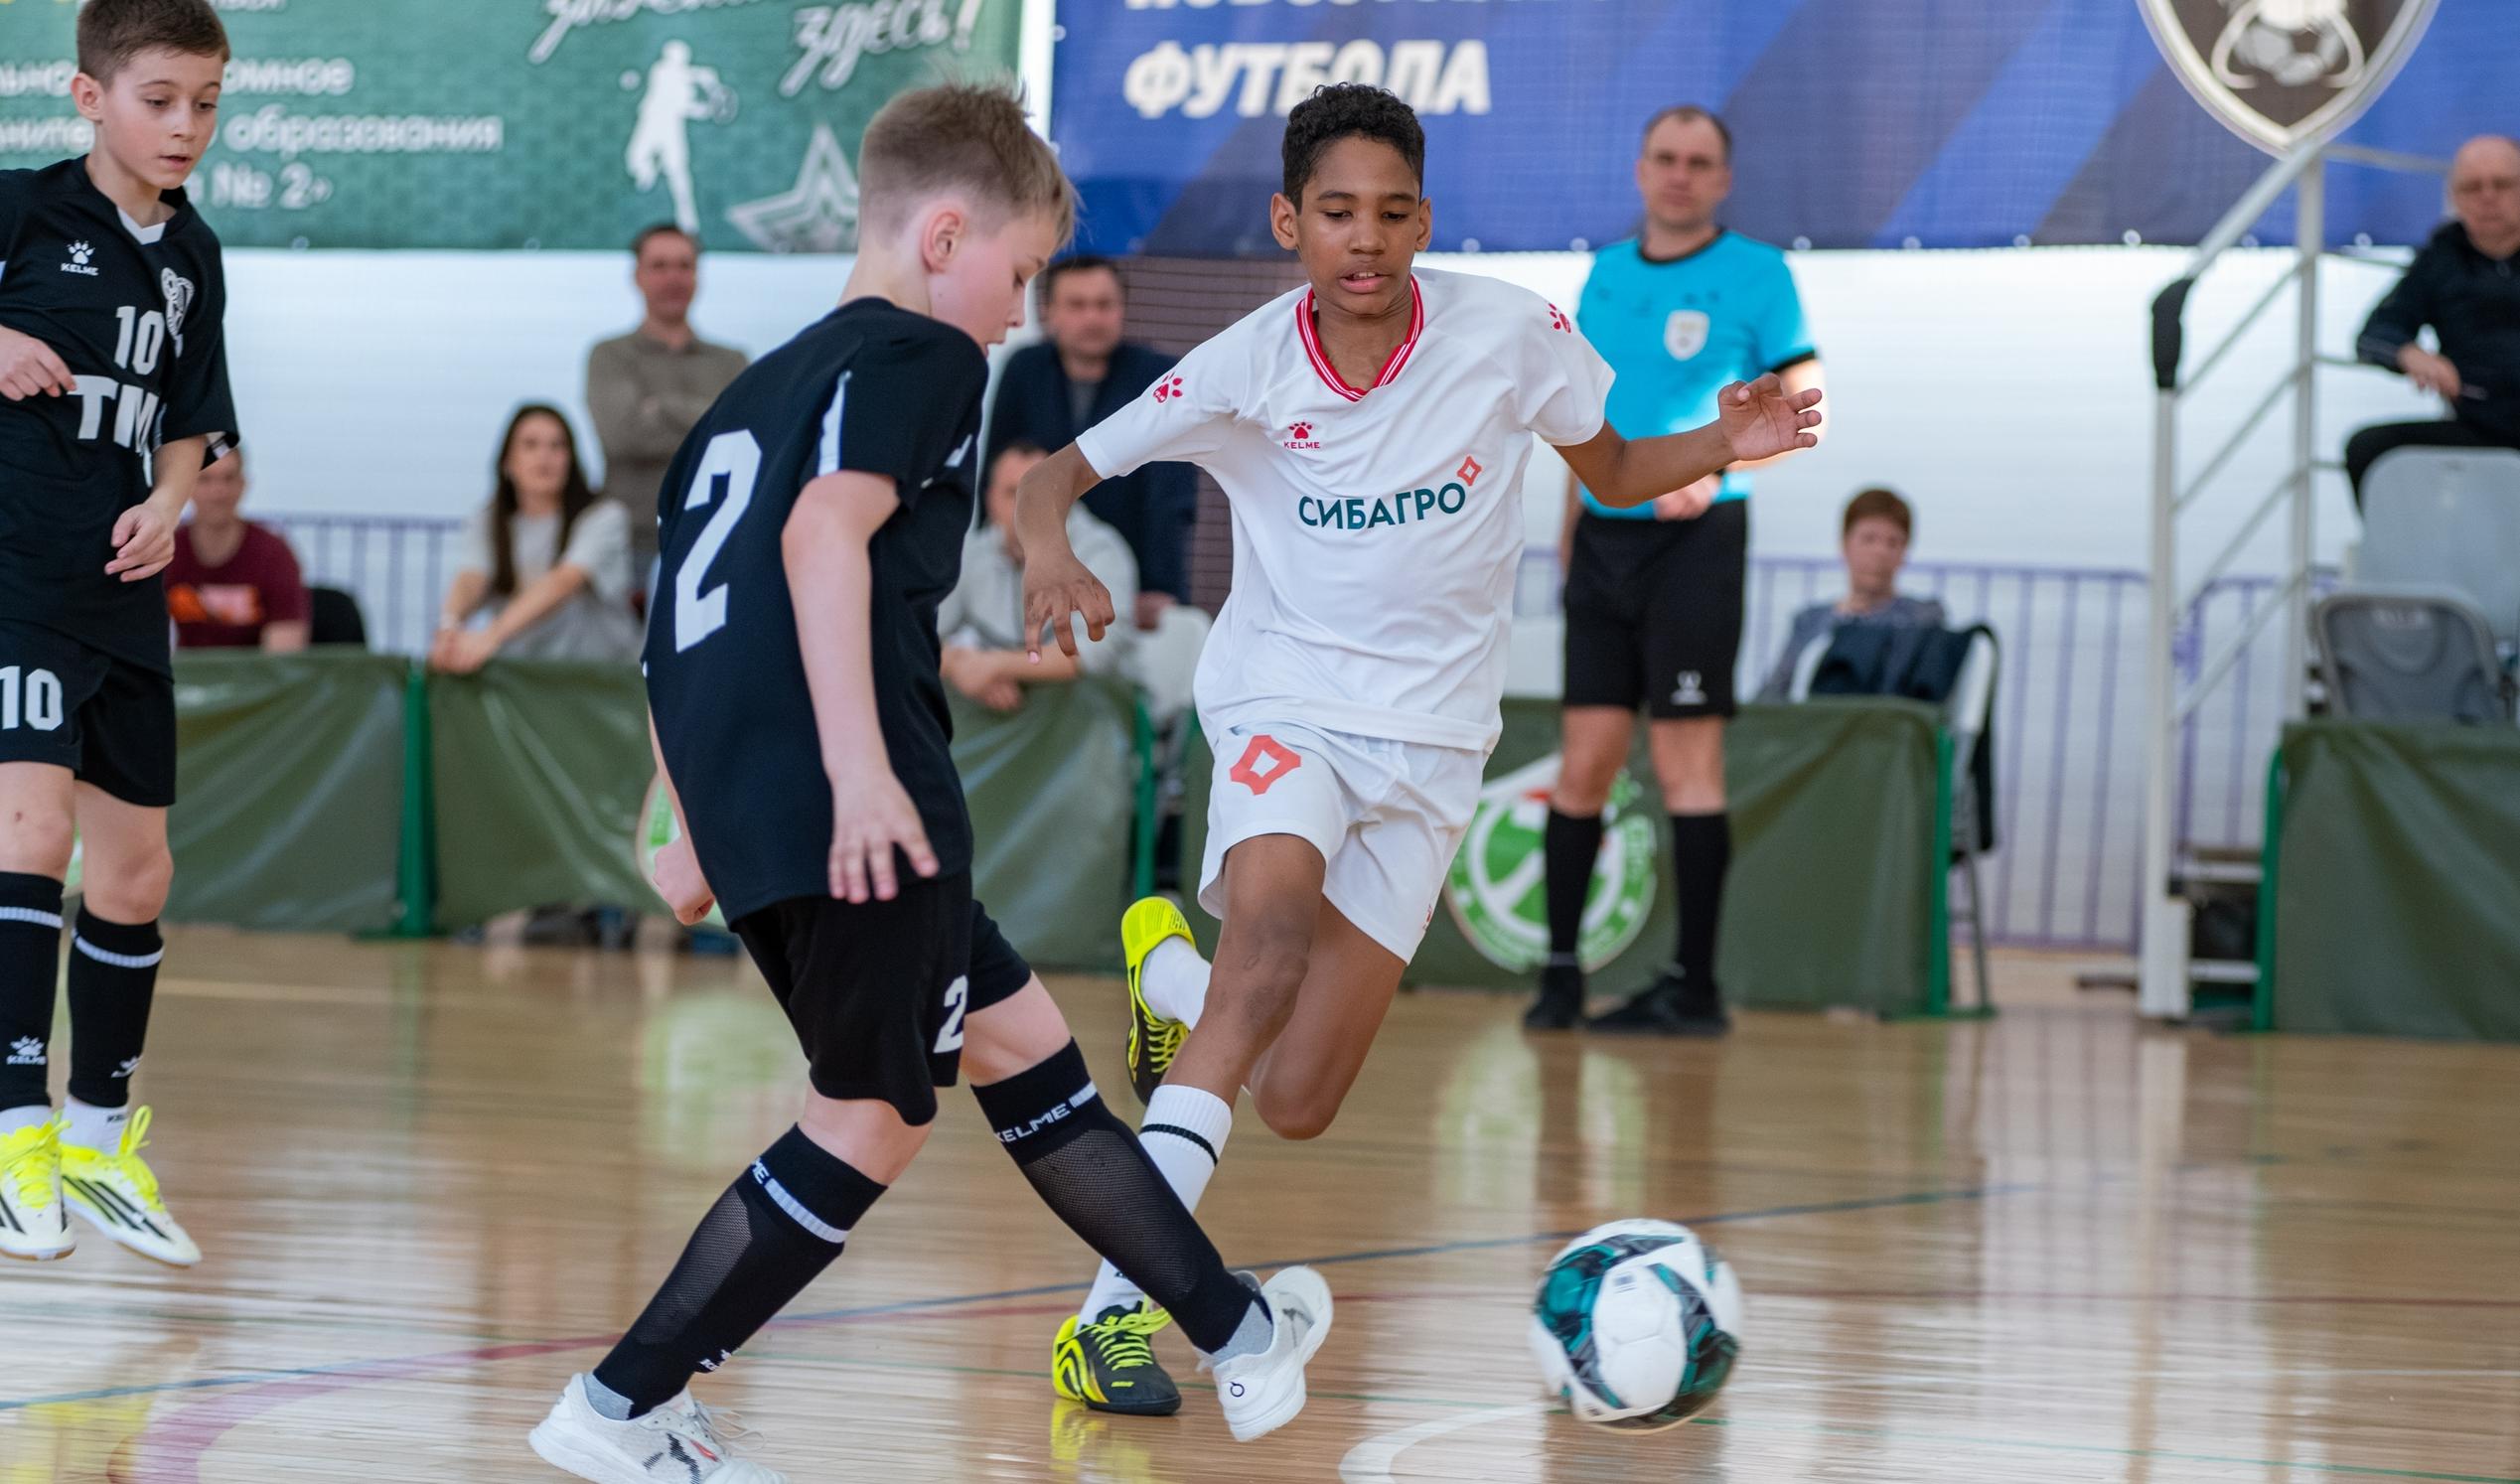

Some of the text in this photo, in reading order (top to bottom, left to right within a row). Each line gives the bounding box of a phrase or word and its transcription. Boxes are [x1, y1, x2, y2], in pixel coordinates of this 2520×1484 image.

[222, 57, 355, 96] омное
[1123, 39, 1491, 119] ФУТБОЛА
[223, 103, 505, 162] образования
[61, 262, 99, 276] KELME
[113, 305, 166, 375] 10
[1283, 441, 1321, 450] KELME
[1297, 482, 1466, 530] СИБАГРО
[674, 428, 763, 654] 2
[0, 666, 64, 731] 10
[932, 974, 968, 1054] 2
